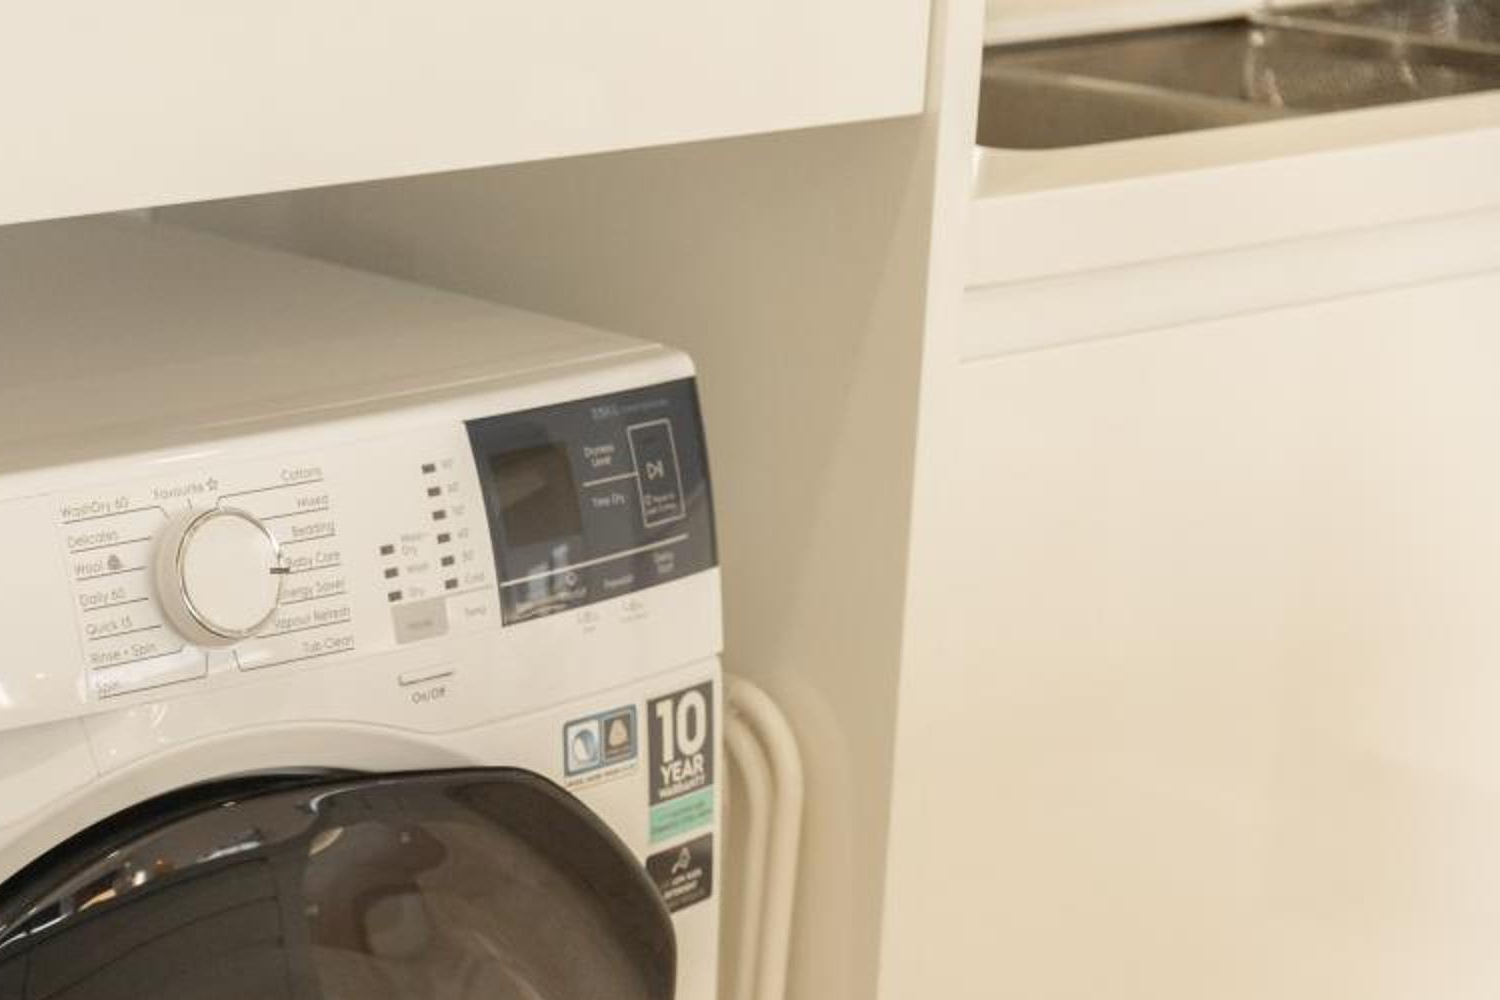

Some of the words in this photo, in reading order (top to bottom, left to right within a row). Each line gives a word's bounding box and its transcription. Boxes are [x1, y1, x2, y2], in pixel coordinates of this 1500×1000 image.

[315, 550, 341, 563] Care
[85, 620, 118, 637] Quick
[321, 633, 355, 649] Clean
[411, 685, 446, 703] On/Off
[655, 689, 706, 763] 10
[660, 753, 704, 785] YEAR
